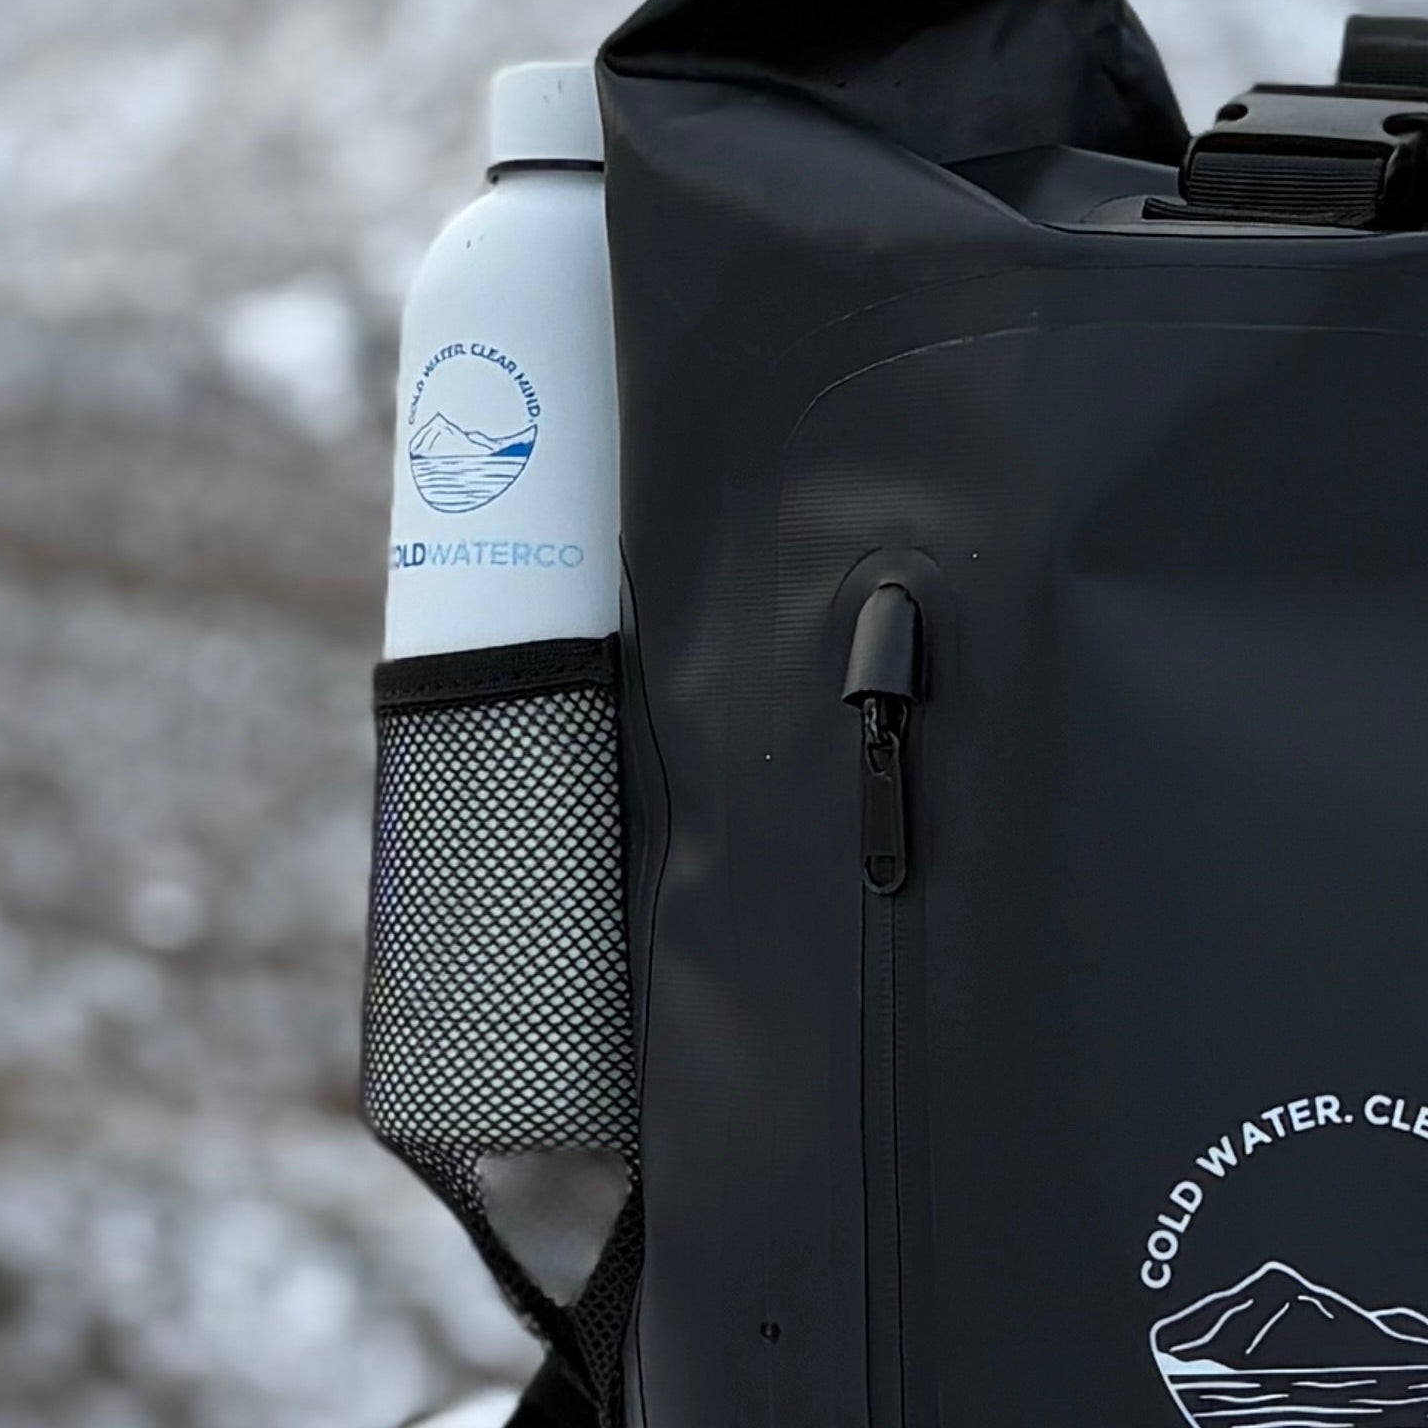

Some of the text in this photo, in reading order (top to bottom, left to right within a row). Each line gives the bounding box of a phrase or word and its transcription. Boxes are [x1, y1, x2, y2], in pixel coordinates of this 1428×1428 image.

[470, 343, 517, 375] CLEAR
[1140, 1180, 1203, 1289] COLD
[1195, 1094, 1354, 1177] WATER.
